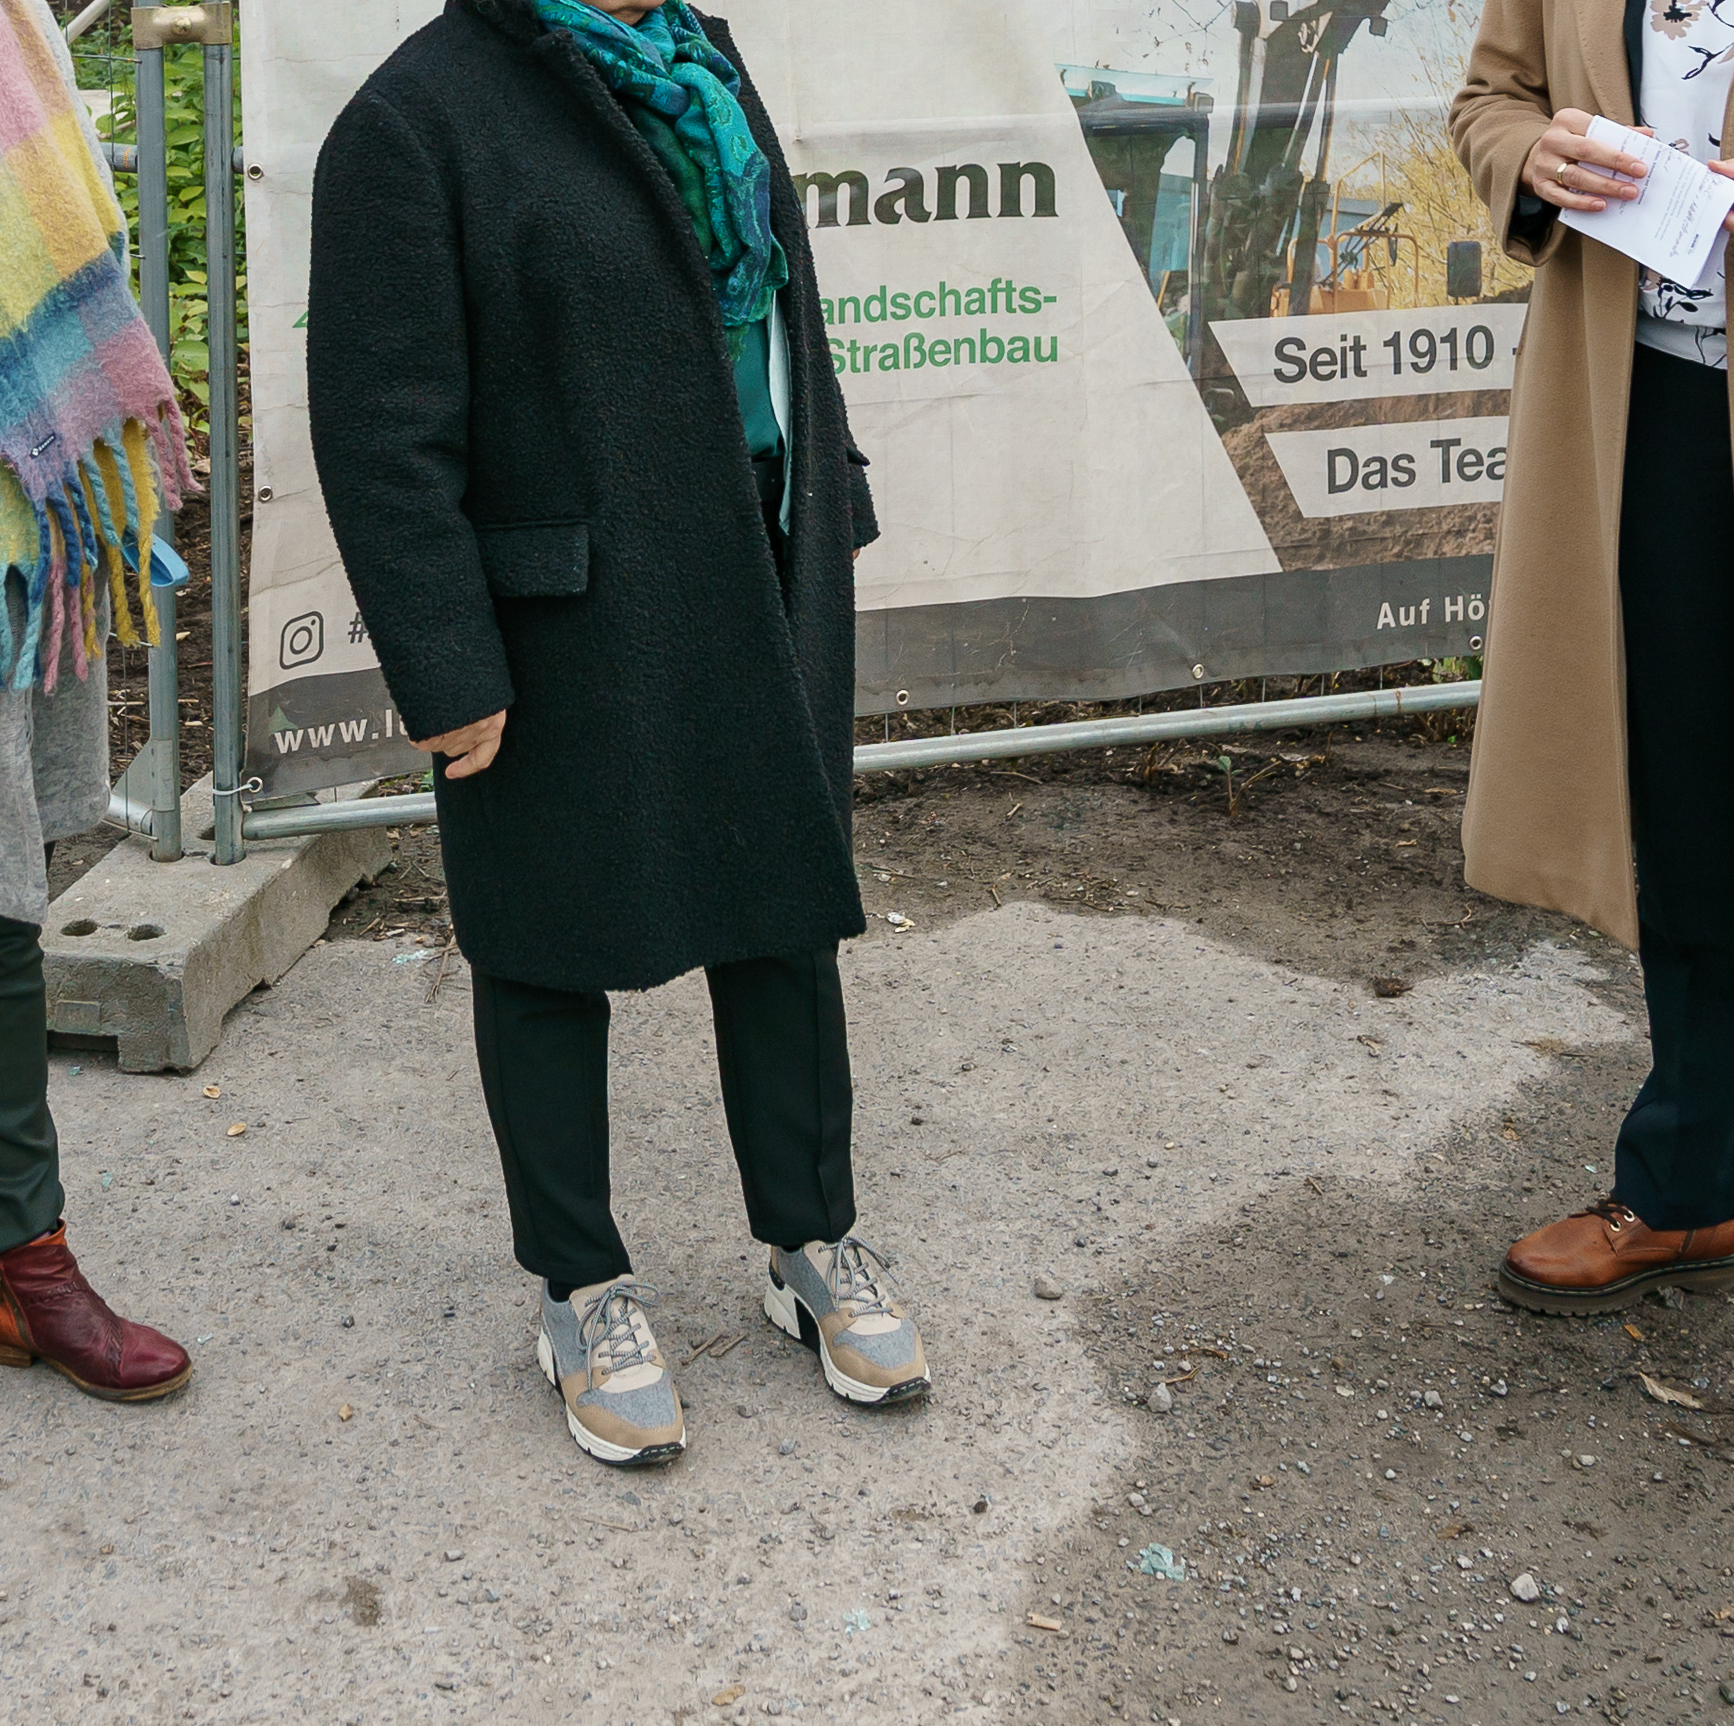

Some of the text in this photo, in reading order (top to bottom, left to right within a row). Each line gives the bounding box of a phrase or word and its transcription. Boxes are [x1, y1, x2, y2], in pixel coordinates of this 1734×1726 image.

[1273, 325, 1494, 384] Seit 1910
[1327, 447, 1416, 495] Das
[1376, 593, 1492, 629] Auf Hö
